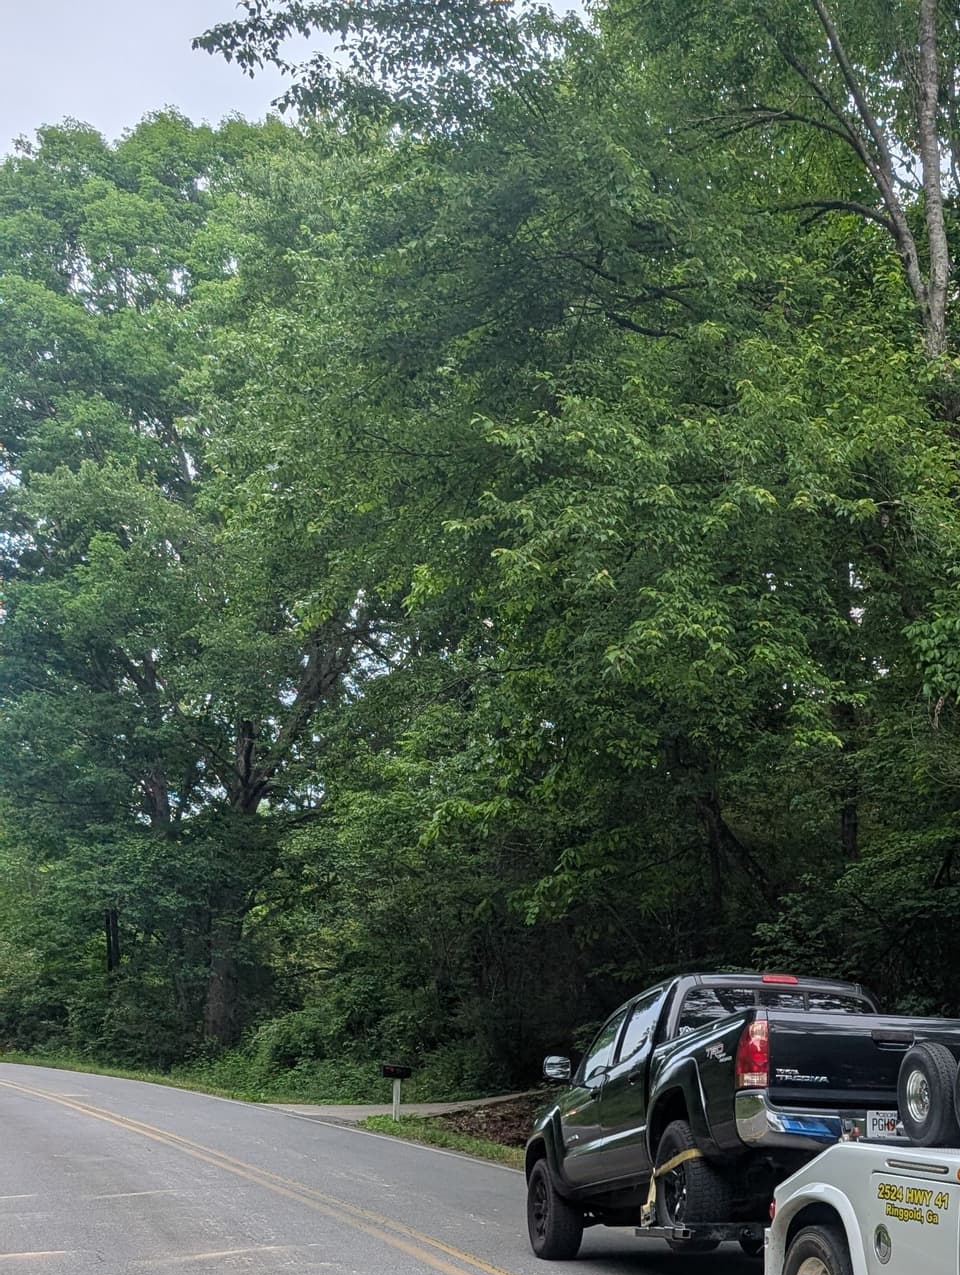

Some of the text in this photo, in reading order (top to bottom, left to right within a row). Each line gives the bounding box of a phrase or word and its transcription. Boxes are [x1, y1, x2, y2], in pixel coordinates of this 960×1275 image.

[776, 1074, 830, 1083] TACOMA
[872, 1118, 896, 1131] PGH9
[878, 1183, 949, 1209] 2524 HWY 41
[885, 1202, 939, 1224] Ringgold, Ga
